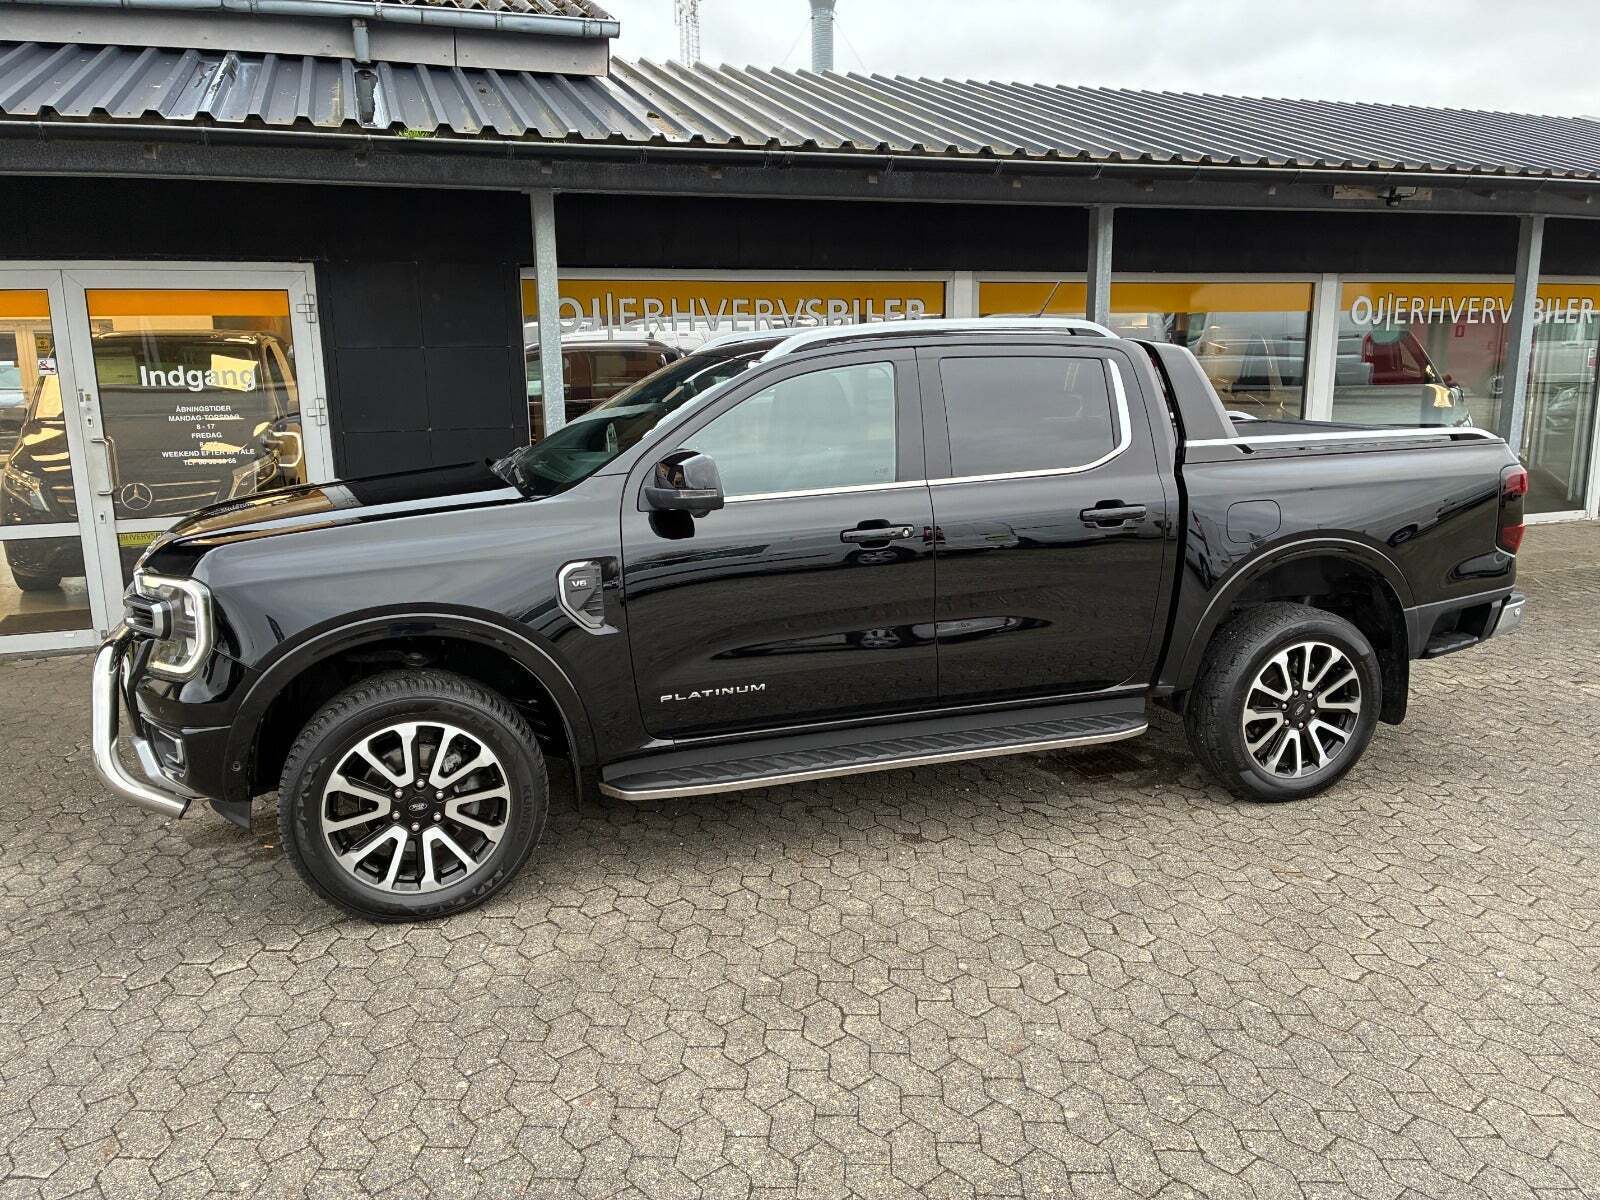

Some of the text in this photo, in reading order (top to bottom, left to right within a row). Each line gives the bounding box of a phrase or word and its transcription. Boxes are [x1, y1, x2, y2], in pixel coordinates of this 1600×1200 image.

[140, 365, 256, 392] Indgang
[176, 405, 231, 413] ÅBNINGSTIDER
[162, 450, 200, 458] WEEKEND
[661, 684, 765, 702] PLATINUM
